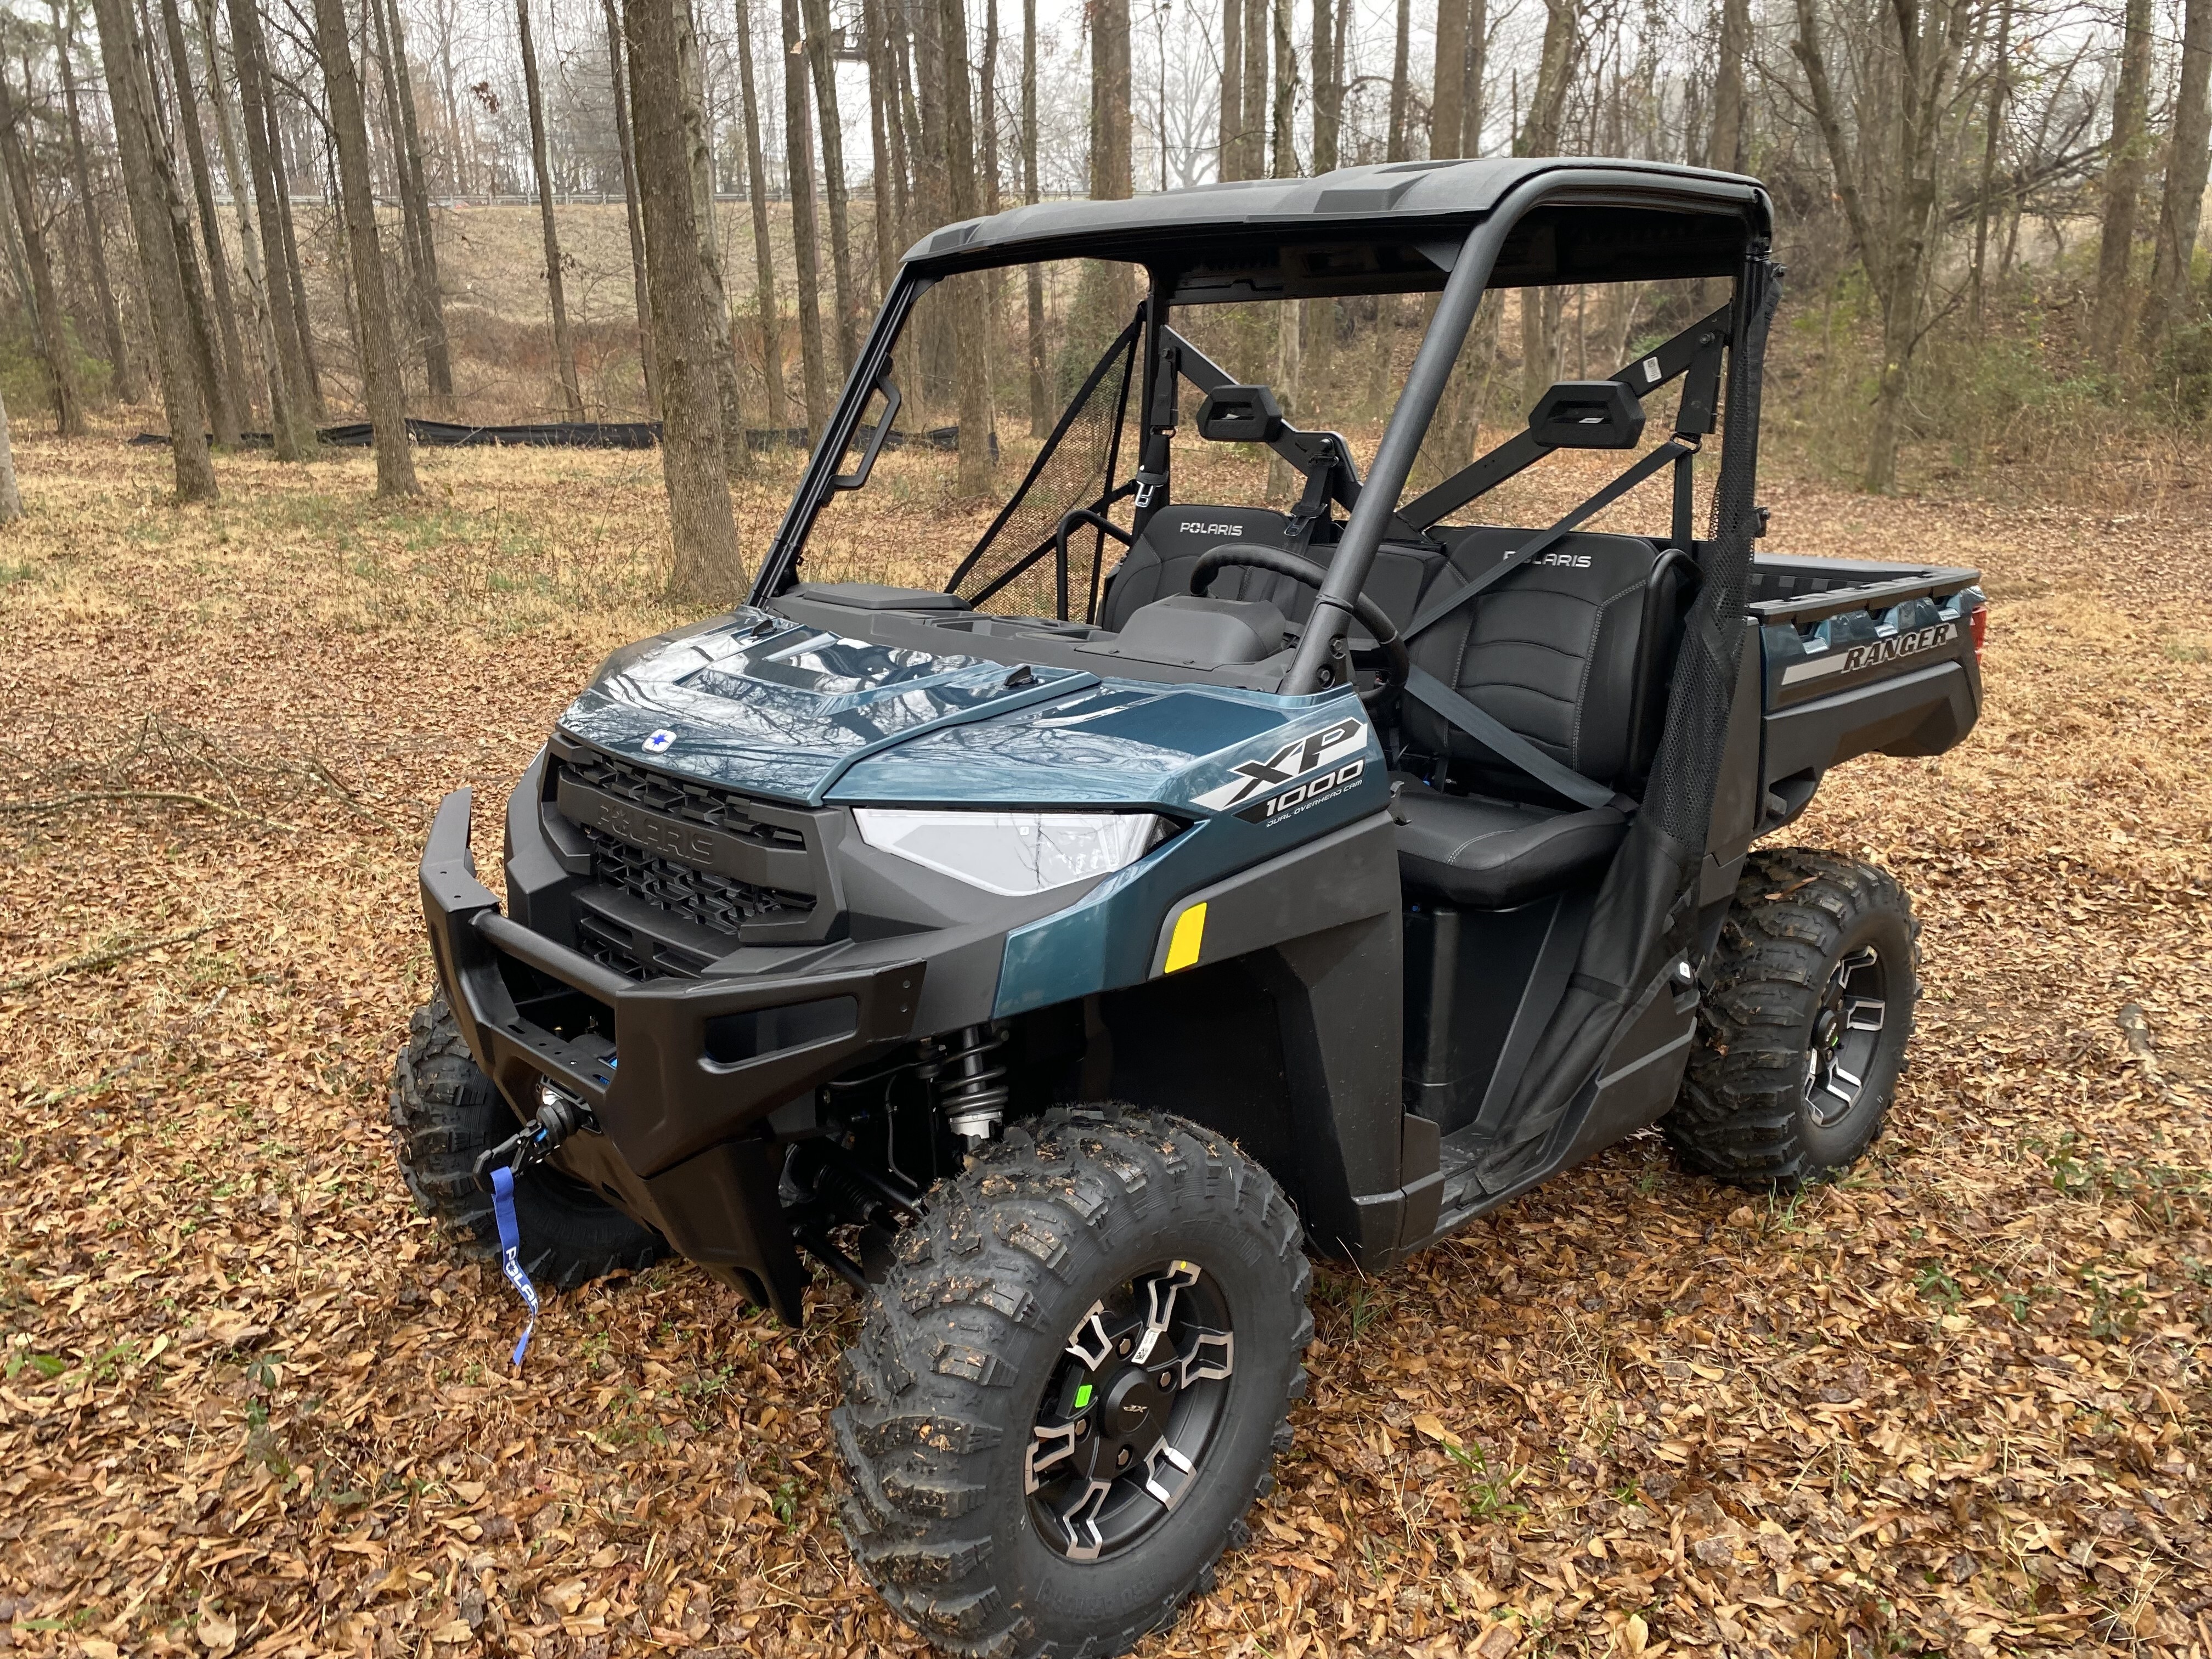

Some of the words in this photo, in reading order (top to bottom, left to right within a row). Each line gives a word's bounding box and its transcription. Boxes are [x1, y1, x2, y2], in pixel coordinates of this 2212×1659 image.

[1180, 522, 1243, 537] POLARIS
[1841, 622, 1951, 674] RANGER
[1222, 717, 1363, 809] XP
[1266, 759, 1364, 817] 1000
[1266, 812, 1292, 827] DUAL
[1294, 788, 1342, 815] OVERHEAD
[1343, 779, 1363, 793] CAM
[597, 803, 713, 865] POLARIS
